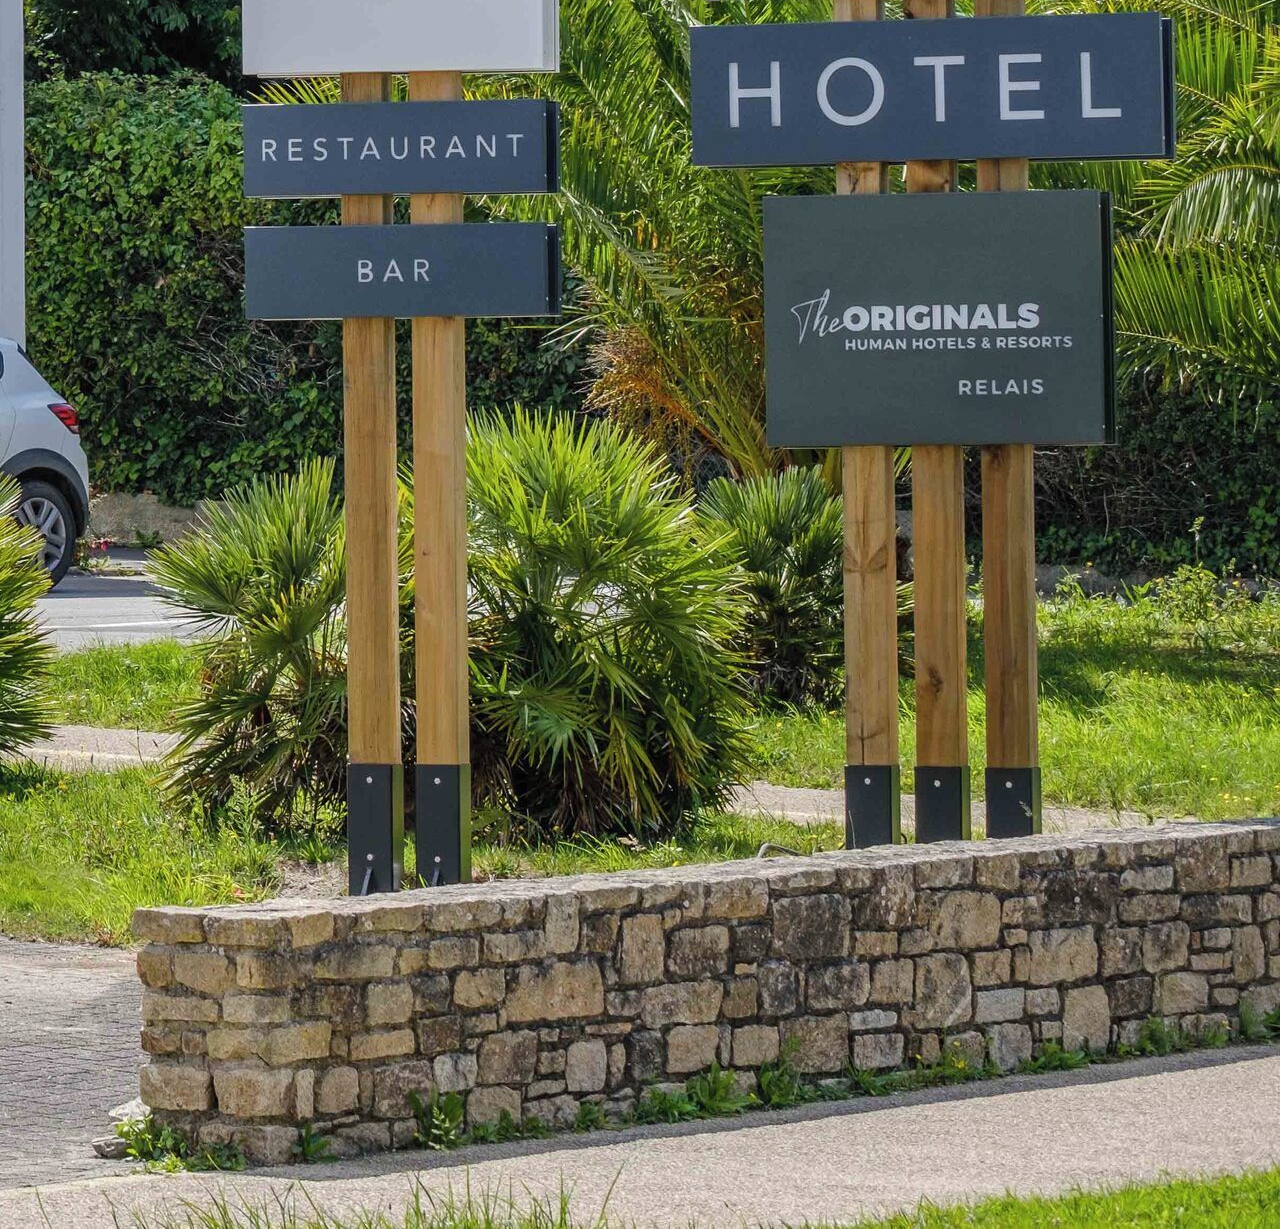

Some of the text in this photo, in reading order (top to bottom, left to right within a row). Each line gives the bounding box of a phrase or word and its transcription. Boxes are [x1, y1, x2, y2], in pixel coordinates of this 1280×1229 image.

[728, 51, 1122, 128] HOTEL
[261, 133, 524, 162] RESTAURANT
[357, 258, 430, 283] BAR
[790, 288, 1040, 345] The ORIGINALS
[844, 335, 1073, 351] HUMAN HOTELS & RESORTS
[958, 378, 1044, 395] RELAIS
